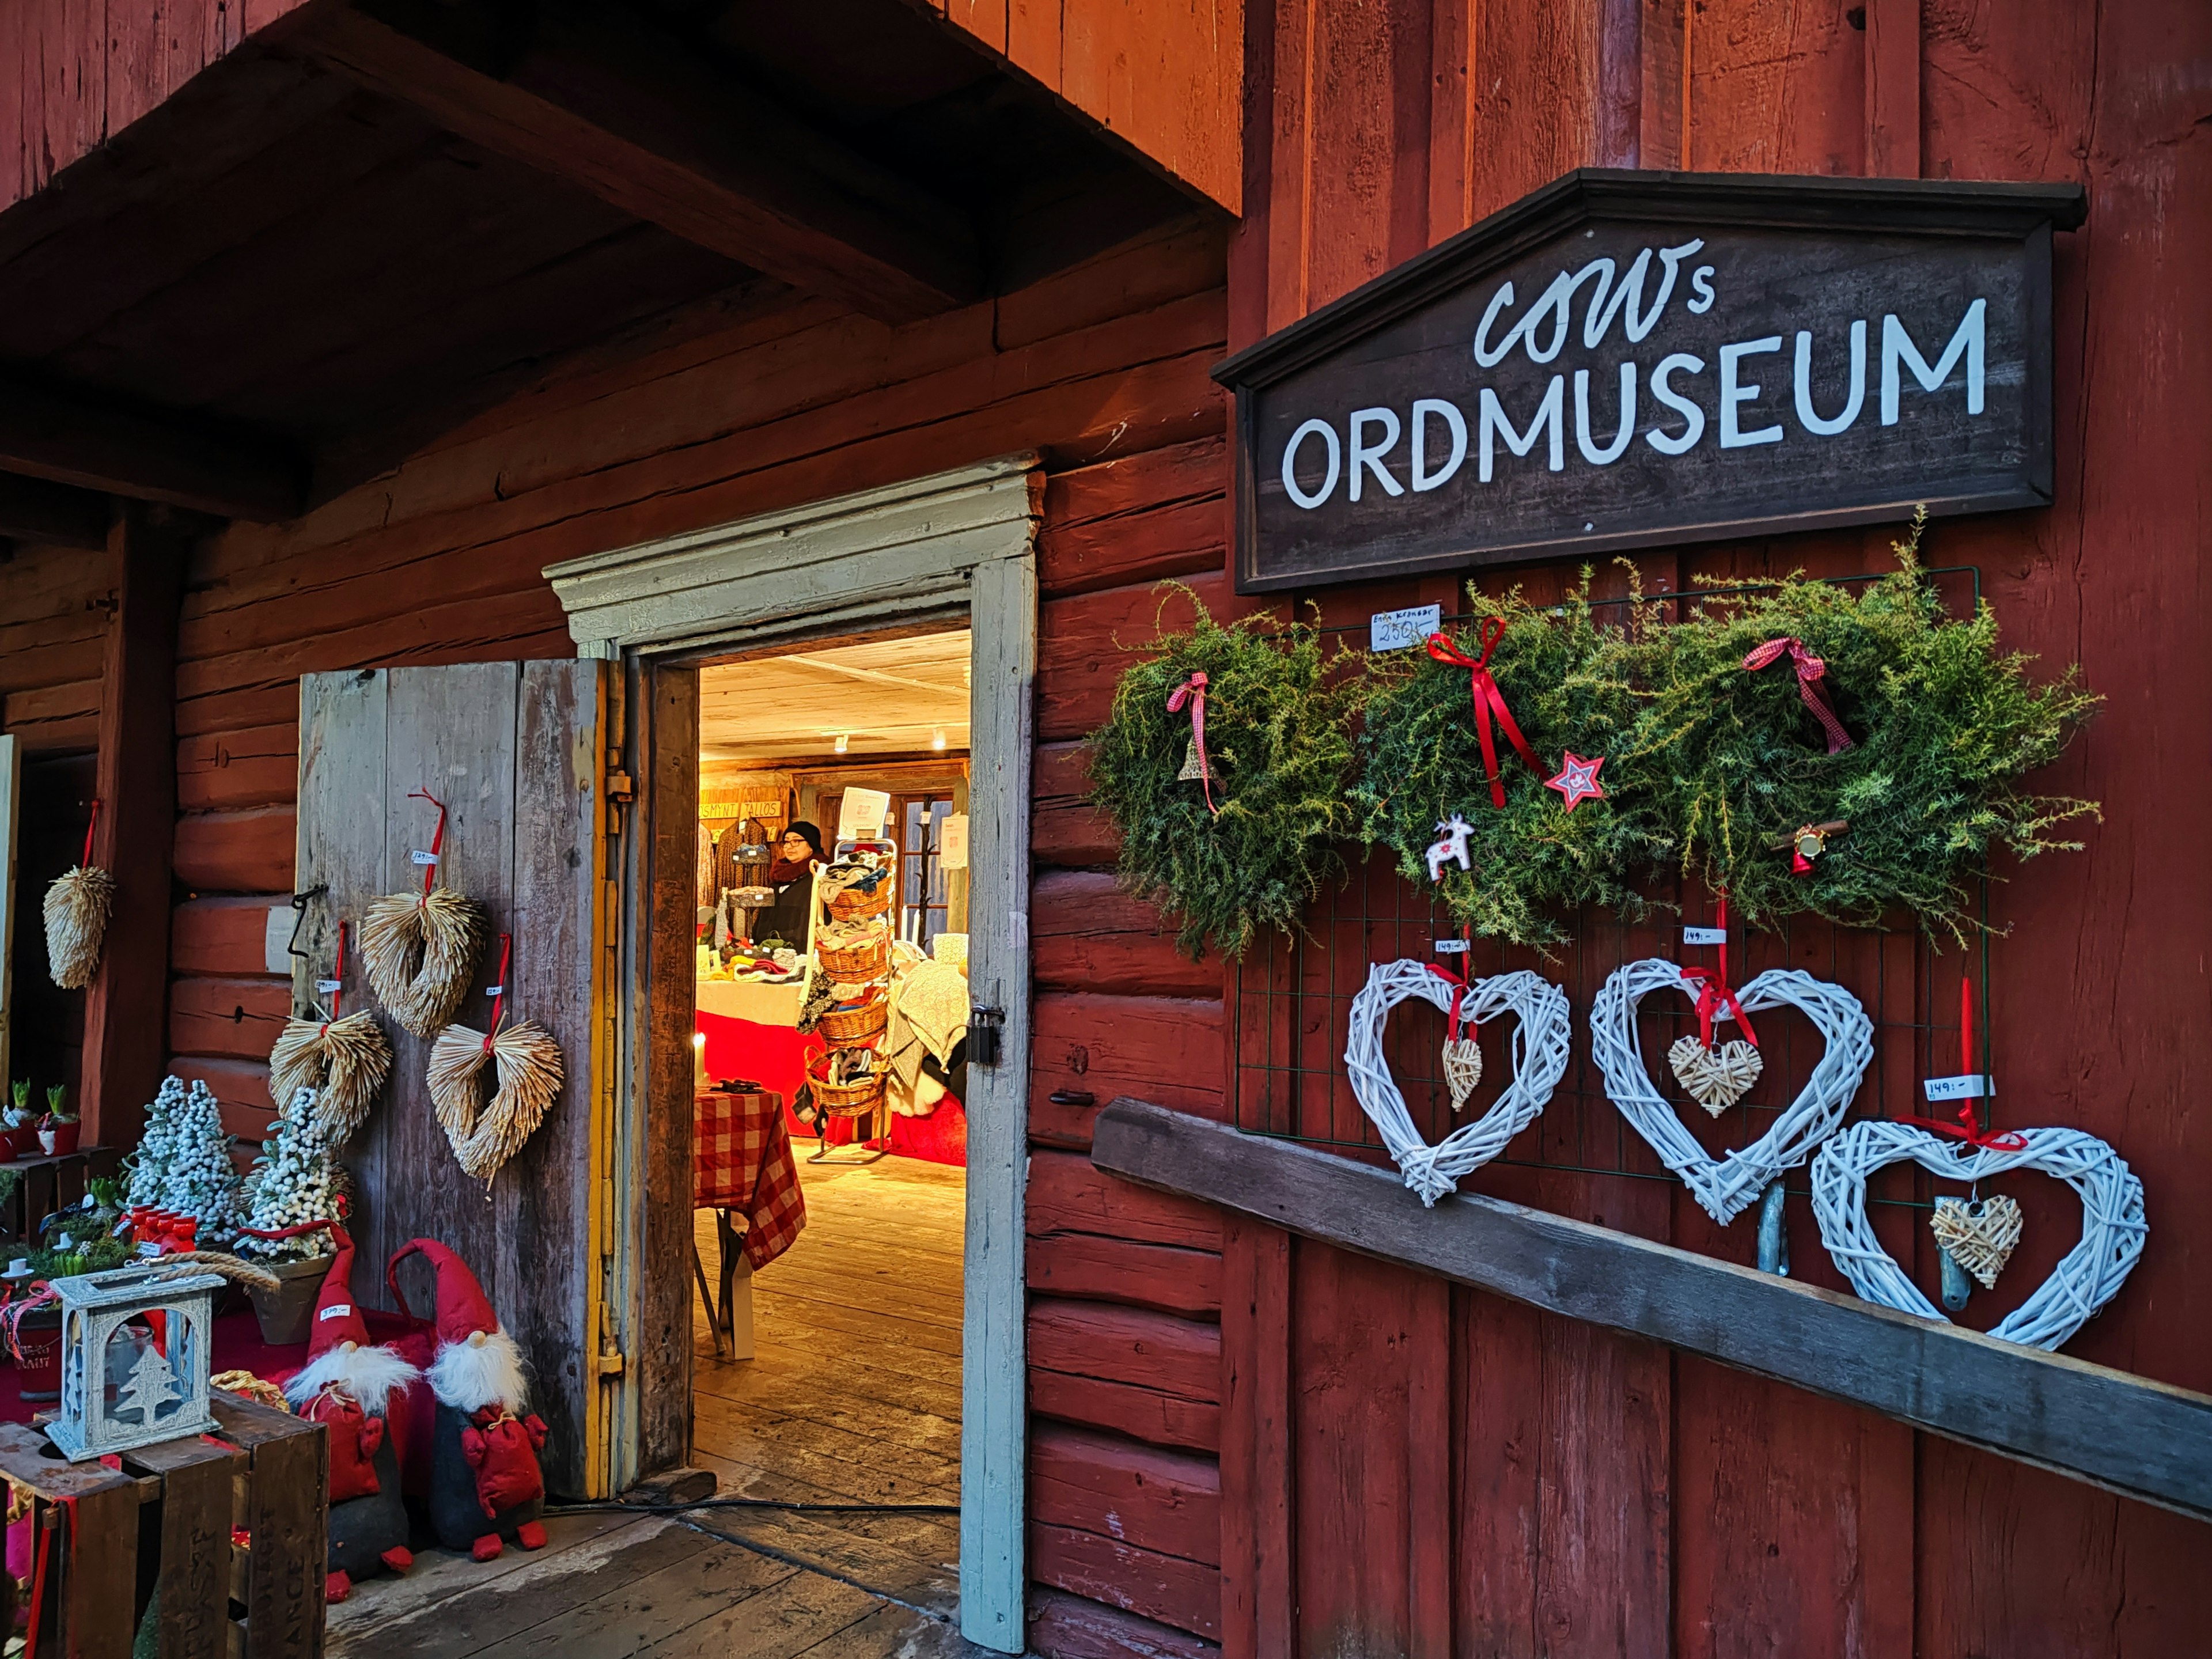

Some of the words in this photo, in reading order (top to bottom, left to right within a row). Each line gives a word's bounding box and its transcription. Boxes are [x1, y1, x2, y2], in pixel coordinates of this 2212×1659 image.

[1282, 298, 1987, 509] ORDMUSEUM
[744, 802, 777, 816] TALLÖS
[1929, 1082, 1965, 1094] 149:-
[323, 1307, 347, 1317] 379:-
